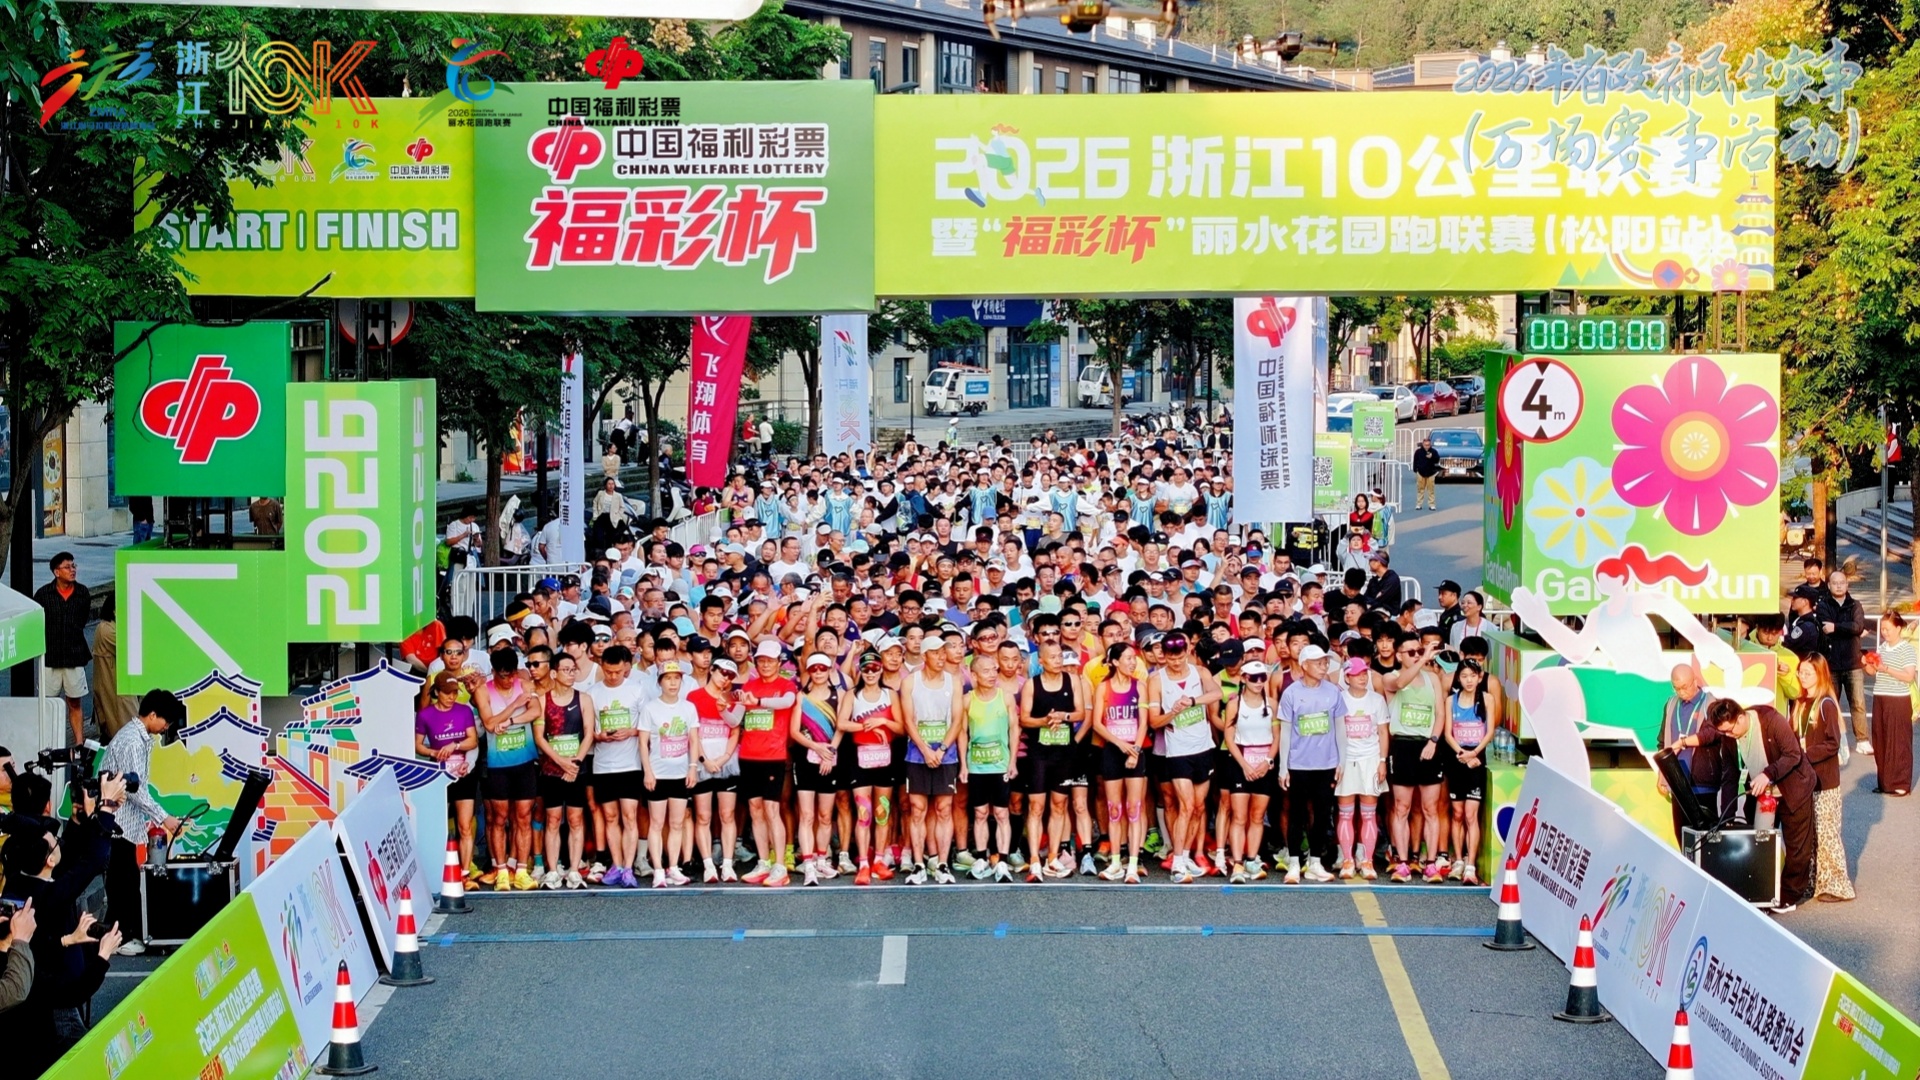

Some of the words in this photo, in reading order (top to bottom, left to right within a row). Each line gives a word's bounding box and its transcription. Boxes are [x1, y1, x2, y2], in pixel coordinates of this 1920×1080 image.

[616, 127, 825, 158] 中国福利彩票
[390, 165, 449, 175] 中国福利彩票
[617, 163, 670, 175] CHINA
[673, 163, 750, 175] WELFARE
[753, 163, 825, 175] LOTTERY
[935, 137, 1131, 199] 2026
[1148, 135, 1722, 199] 浙江10公里联赛
[159, 212, 287, 249] START
[317, 212, 457, 249] FINISH
[526, 187, 825, 281] 福彩杯
[692, 352, 721, 464] 飞翔体育
[1521, 378, 1553, 420] 4
[1554, 410, 1566, 420] m
[304, 400, 381, 626] 2026
[603, 717, 629, 726] A1232
[748, 716, 771, 725] A1037
[1178, 708, 1202, 722] A1002
[1303, 718, 1329, 730] A1179
[921, 728, 946, 738] A1120
[1457, 729, 1481, 738] B2121
[552, 742, 578, 751] A1020
[976, 748, 1000, 758] A1126
[1533, 820, 1591, 890] 中国福利彩票
[1558, 886, 1578, 910] LOTTERY
[1702, 954, 1805, 1068] 丽水市马拉松及路跑协会
[1730, 1033, 1741, 1053] AND
